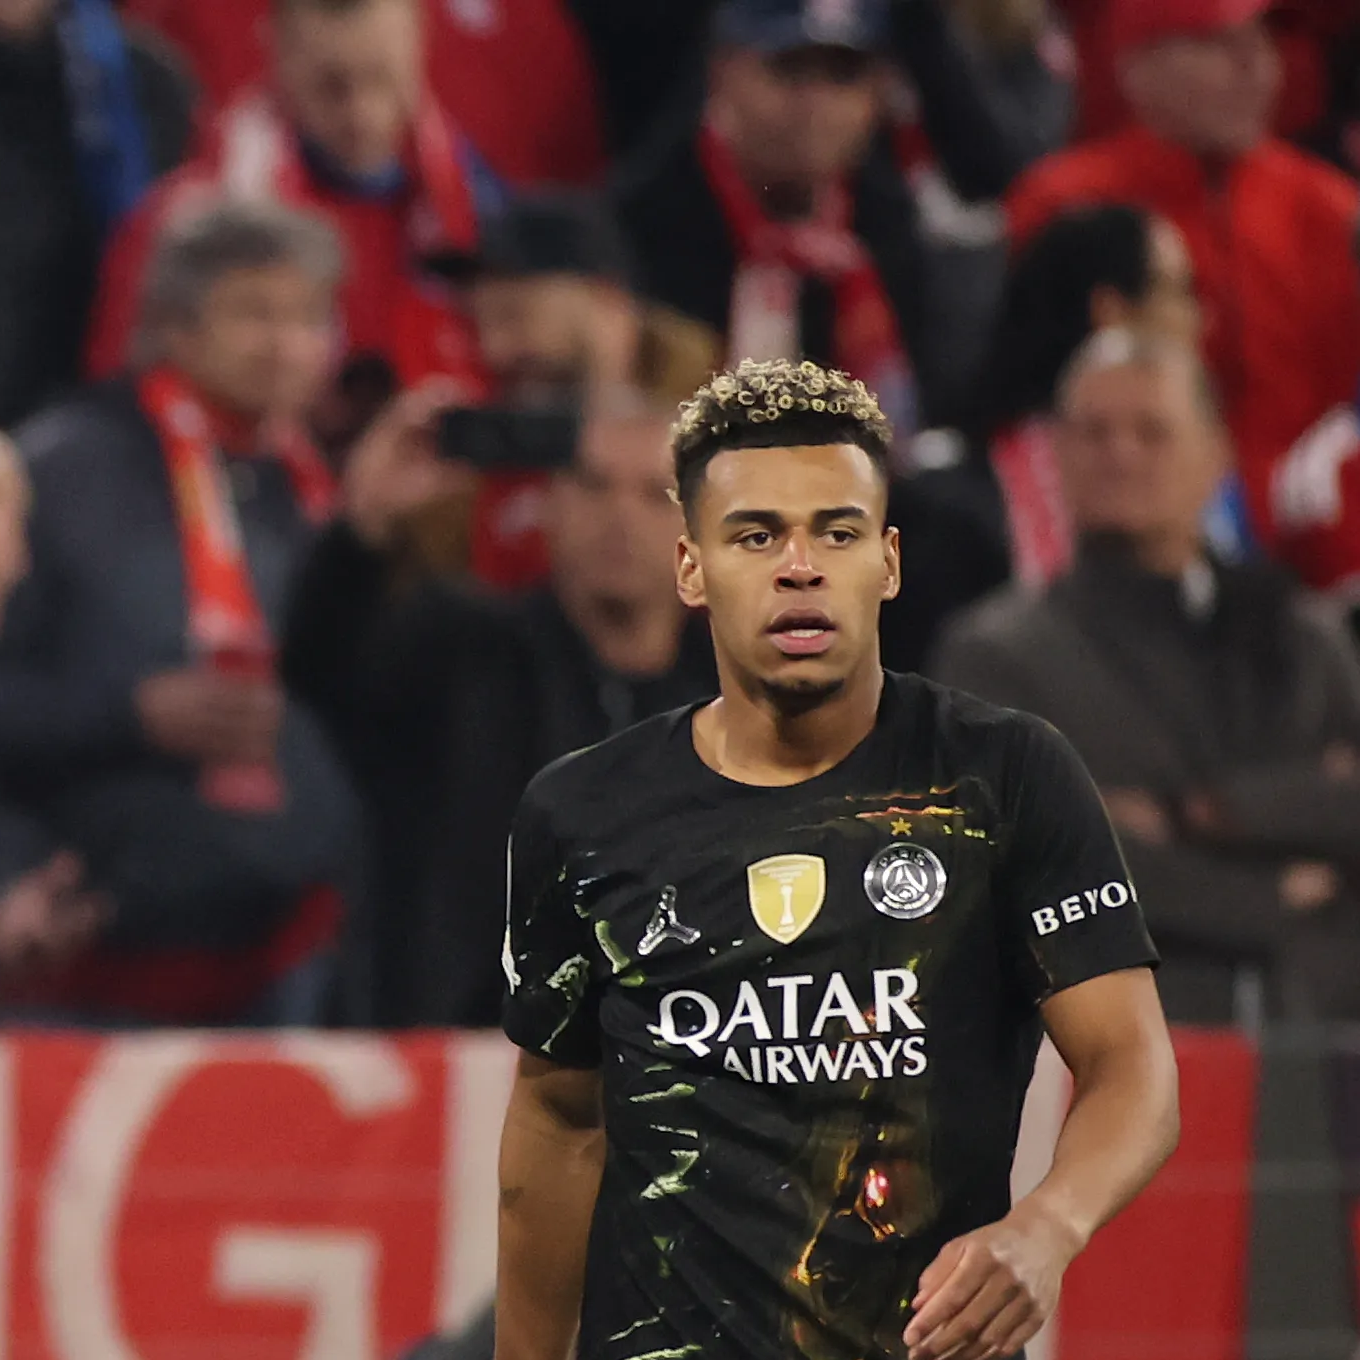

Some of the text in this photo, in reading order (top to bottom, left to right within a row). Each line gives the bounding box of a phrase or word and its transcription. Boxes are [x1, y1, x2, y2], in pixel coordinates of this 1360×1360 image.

[1031, 879, 1138, 936] BEYO
[659, 967, 927, 1058] QATAR
[723, 1036, 928, 1084] AIRWAYS
